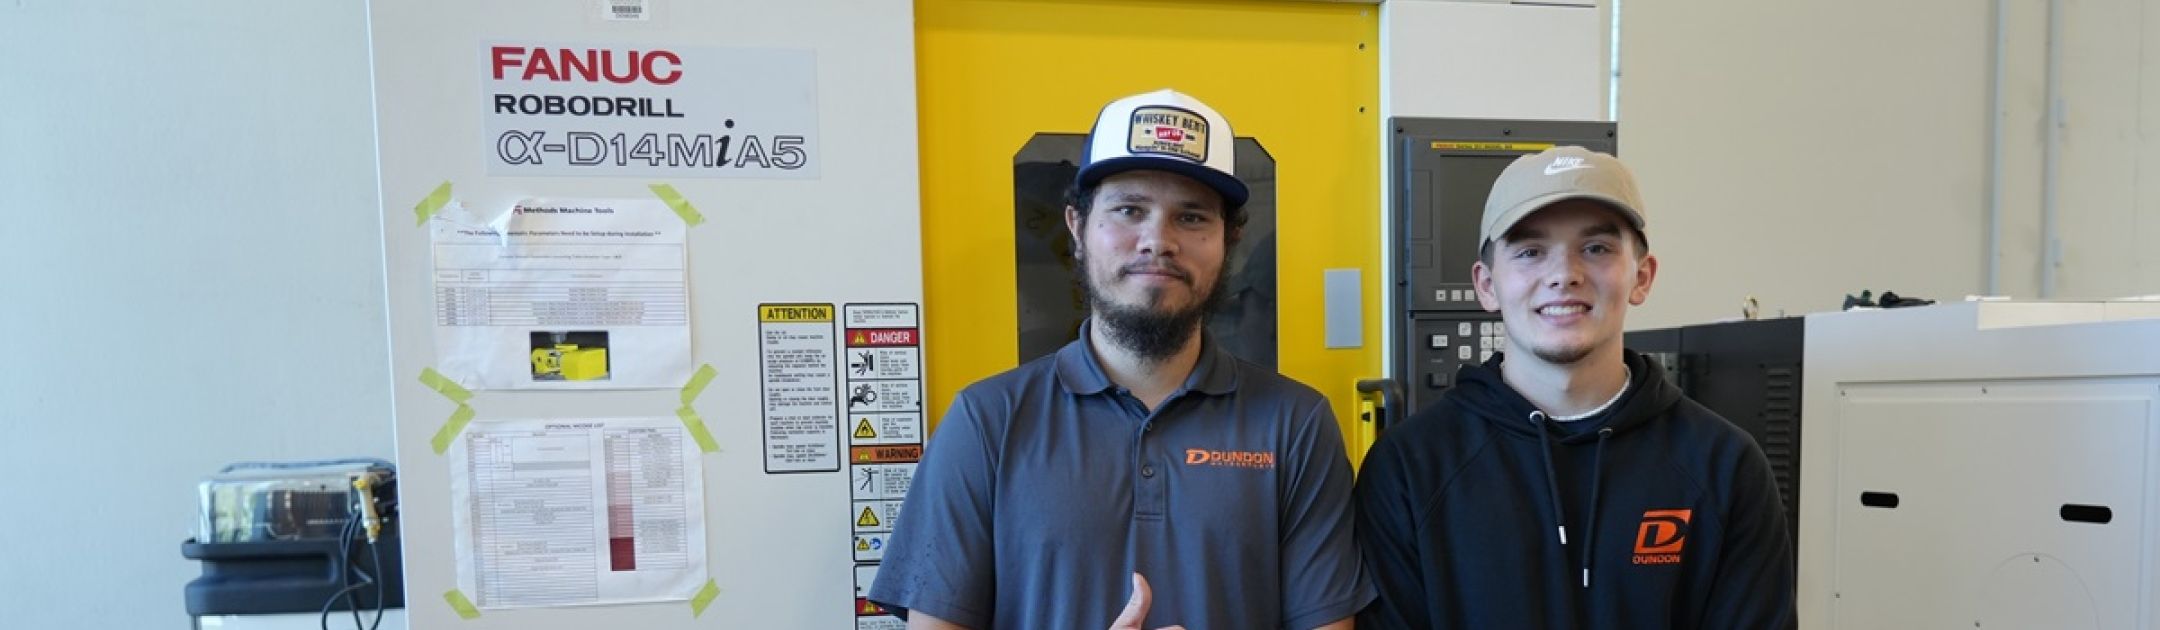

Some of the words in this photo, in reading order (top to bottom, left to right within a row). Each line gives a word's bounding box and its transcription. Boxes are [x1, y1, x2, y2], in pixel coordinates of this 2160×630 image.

[491, 46, 683, 85] FANUC
[494, 93, 684, 118] ROBODRILL
[1135, 113, 1179, 127] WHISKEY
[1182, 116, 1205, 134] BENT
[1552, 156, 1585, 167] NIKE
[523, 206, 558, 214] Methods
[559, 206, 592, 214] Machine
[767, 308, 827, 320] ATTENTION
[870, 331, 910, 343] DANGER
[876, 447, 919, 460] WARNING
[1632, 555, 1681, 565] DUNDON
